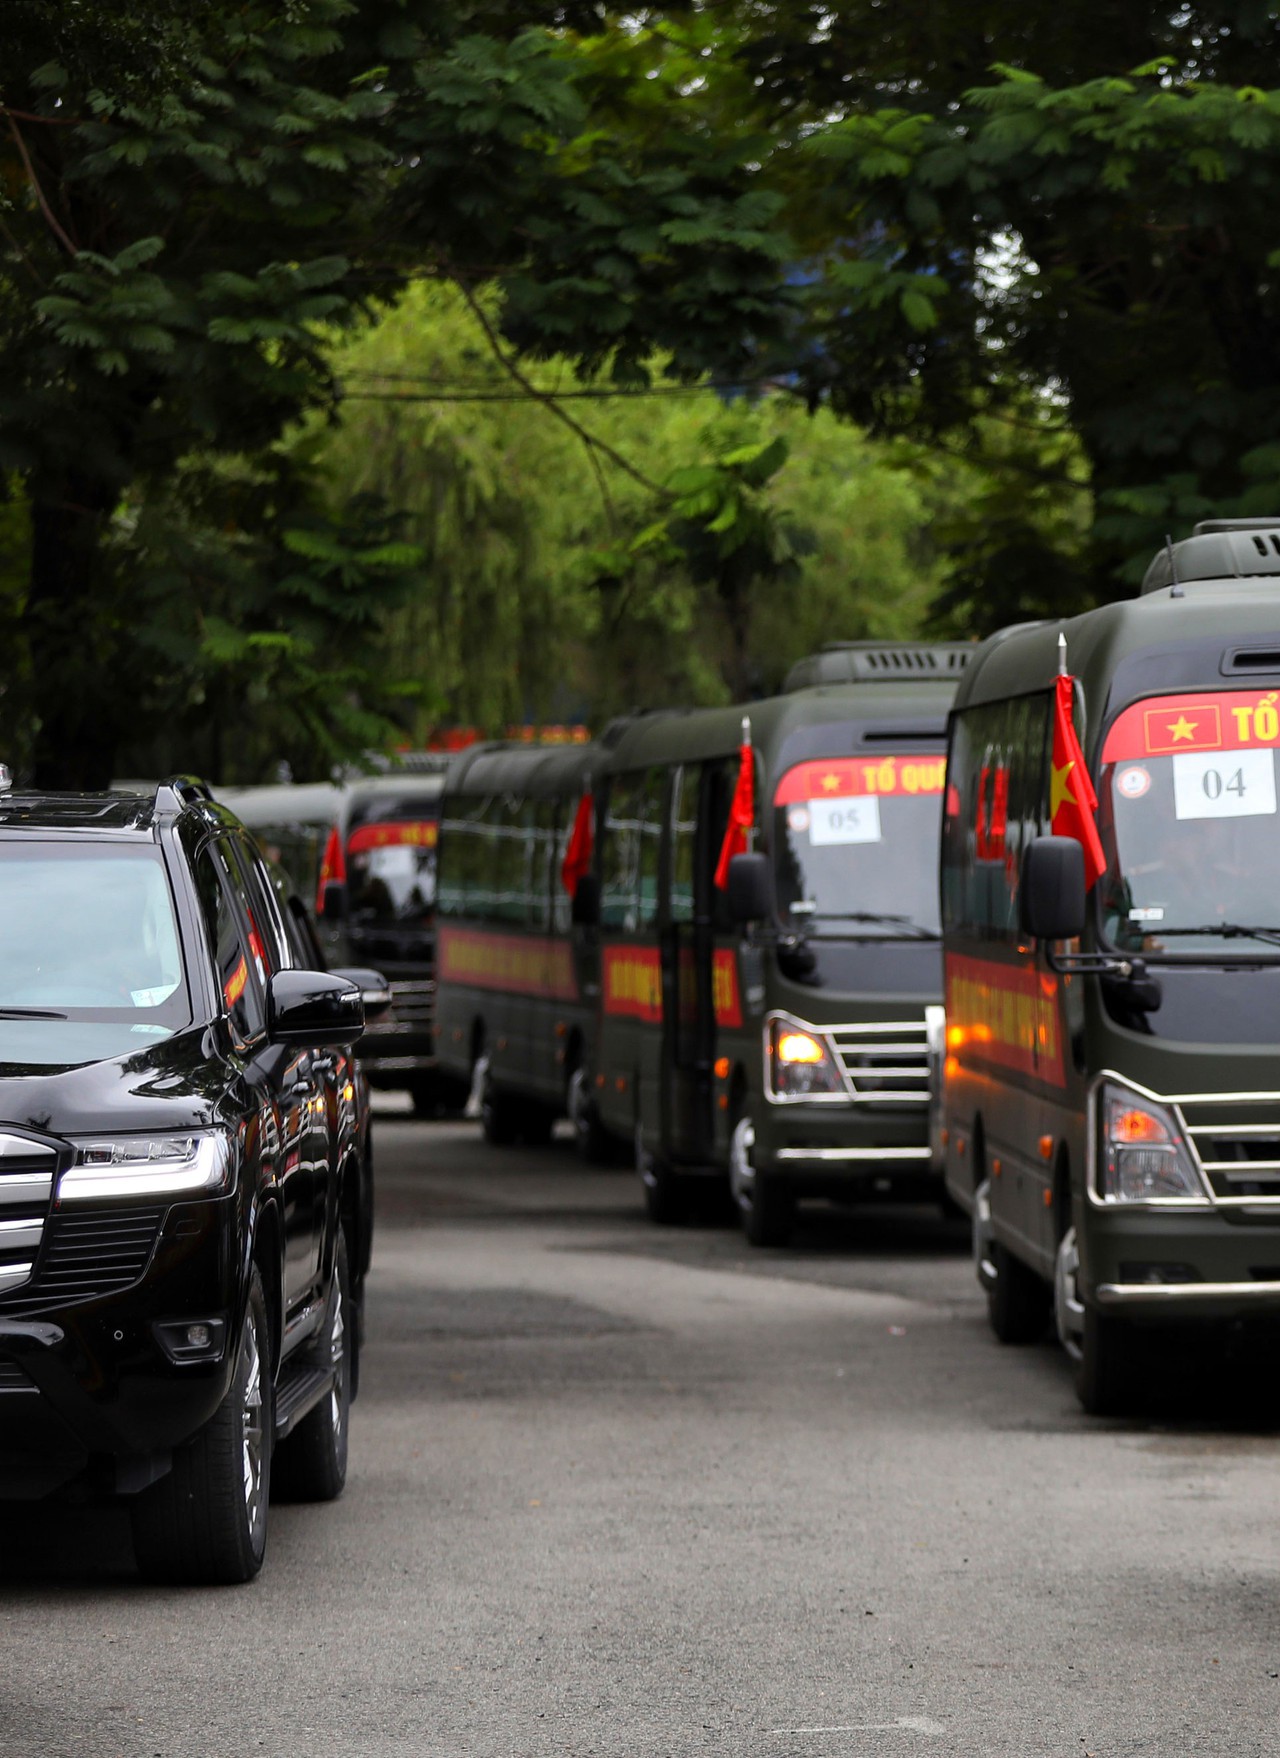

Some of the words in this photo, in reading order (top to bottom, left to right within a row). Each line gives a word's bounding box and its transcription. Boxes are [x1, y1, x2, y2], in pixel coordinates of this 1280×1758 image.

[1231, 692, 1279, 742] TỔ
[1203, 767, 1246, 800] 04
[828, 809, 860, 830] 05
